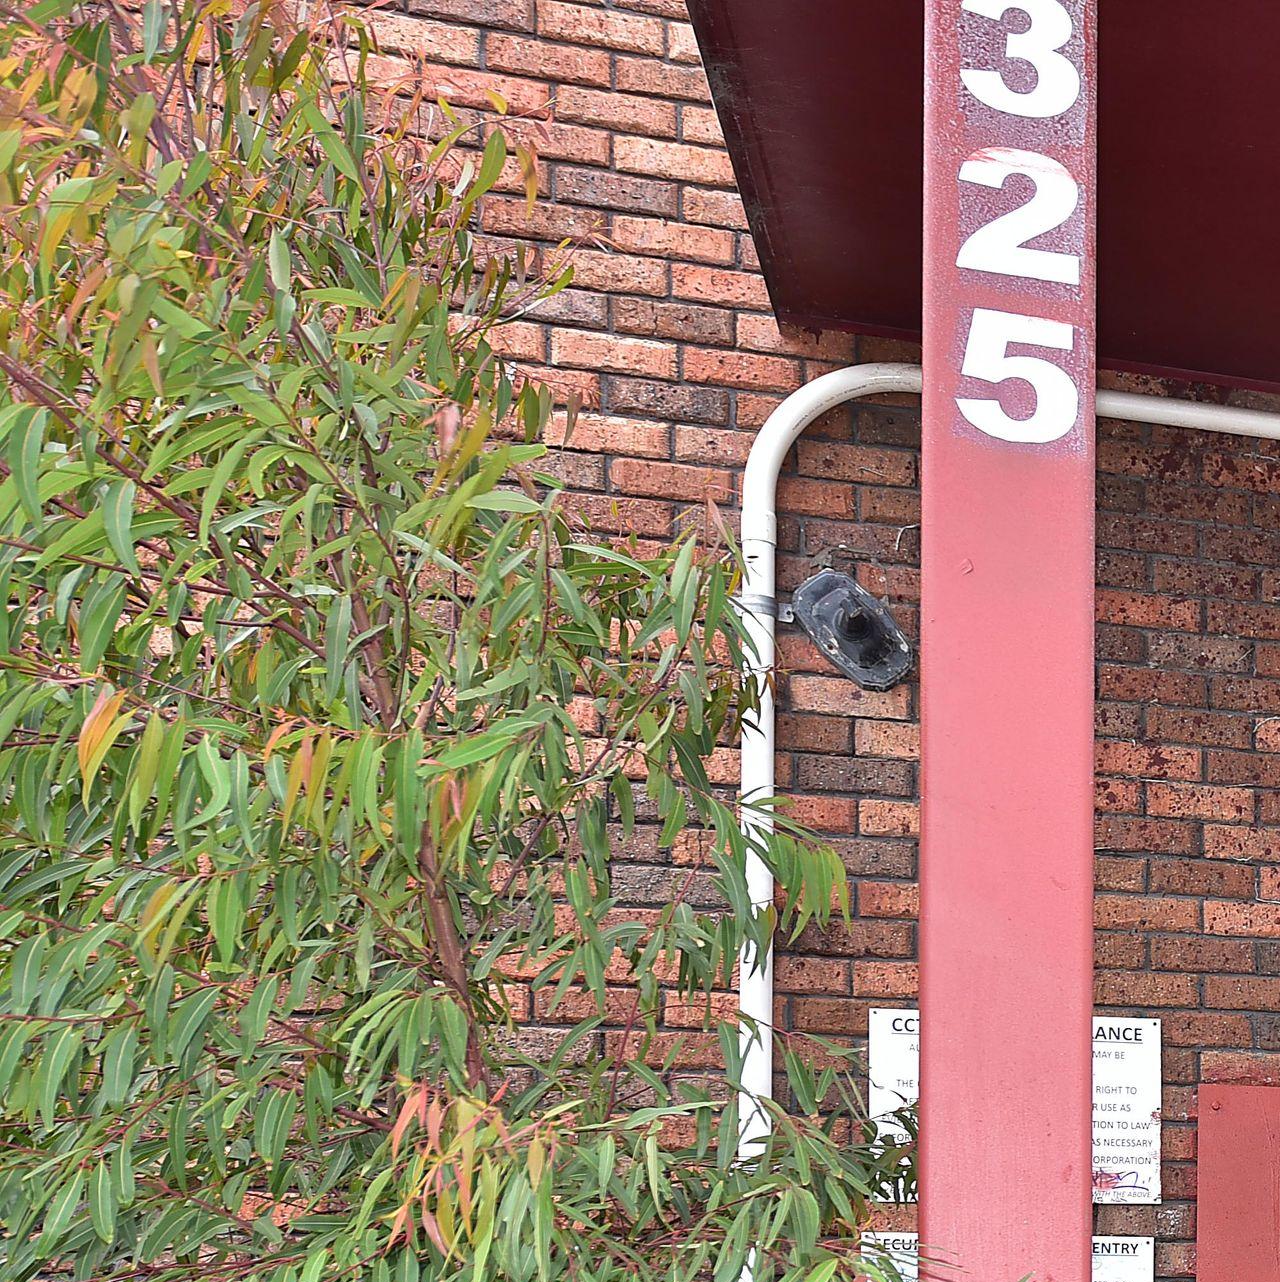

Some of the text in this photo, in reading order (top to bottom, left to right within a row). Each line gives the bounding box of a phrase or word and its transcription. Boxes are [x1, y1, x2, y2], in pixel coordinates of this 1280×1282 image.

[1092, 1026, 1143, 1042] ANCE
[1114, 1051, 1126, 1060] BE
[896, 1078, 914, 1088] THE
[1095, 1085, 1138, 1095] RIGHT TO
[1100, 1104, 1117, 1112] USE
[1120, 1104, 1132, 1112] AS
[1116, 1121, 1129, 1130] TO
[1131, 1122, 1151, 1130] LAW
[1103, 1138, 1153, 1148] NECESSARY
[1092, 1242, 1139, 1254] ENTRY
